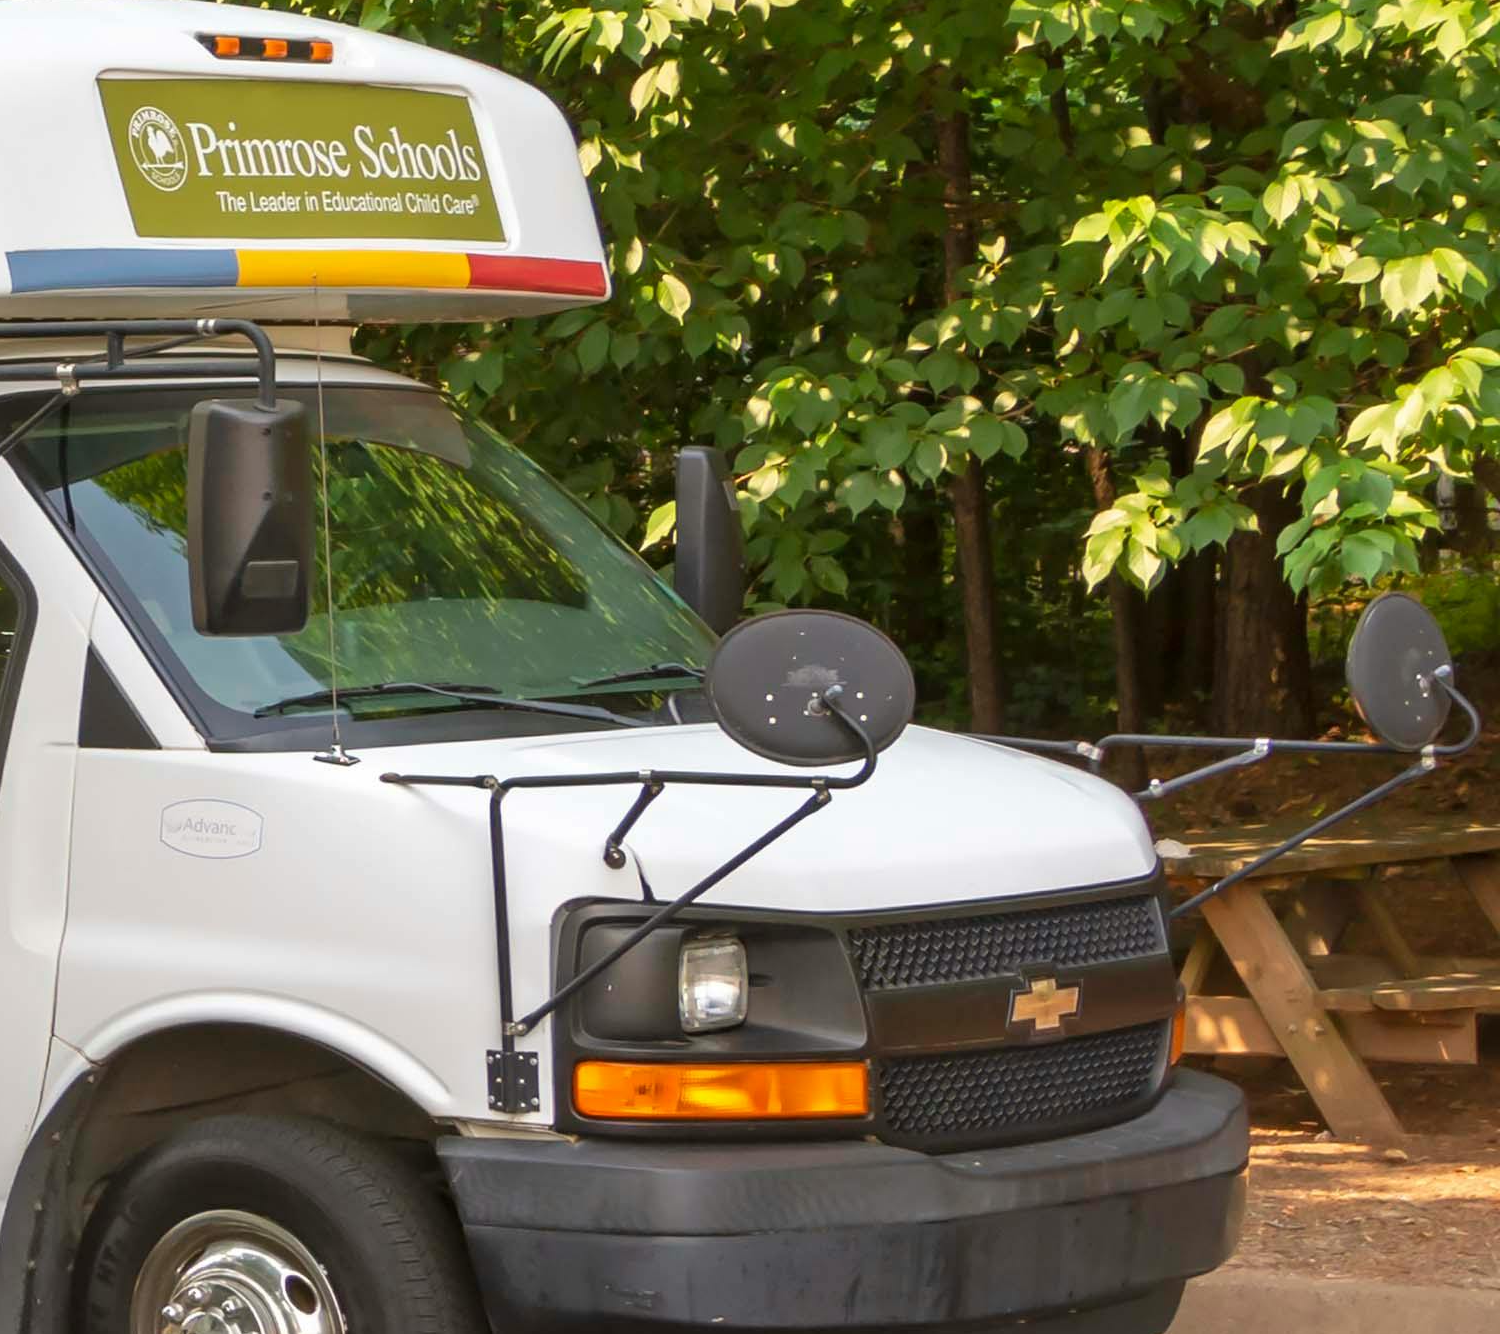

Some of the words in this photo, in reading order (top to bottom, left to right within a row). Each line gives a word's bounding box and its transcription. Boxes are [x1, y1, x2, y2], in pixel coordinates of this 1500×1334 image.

[186, 121, 351, 178] Primrose
[353, 125, 481, 181] Schools
[215, 191, 247, 213] The
[249, 191, 301, 213] Leader
[304, 192, 320, 212] in
[321, 190, 404, 213] Educational
[404, 192, 441, 215] Child
